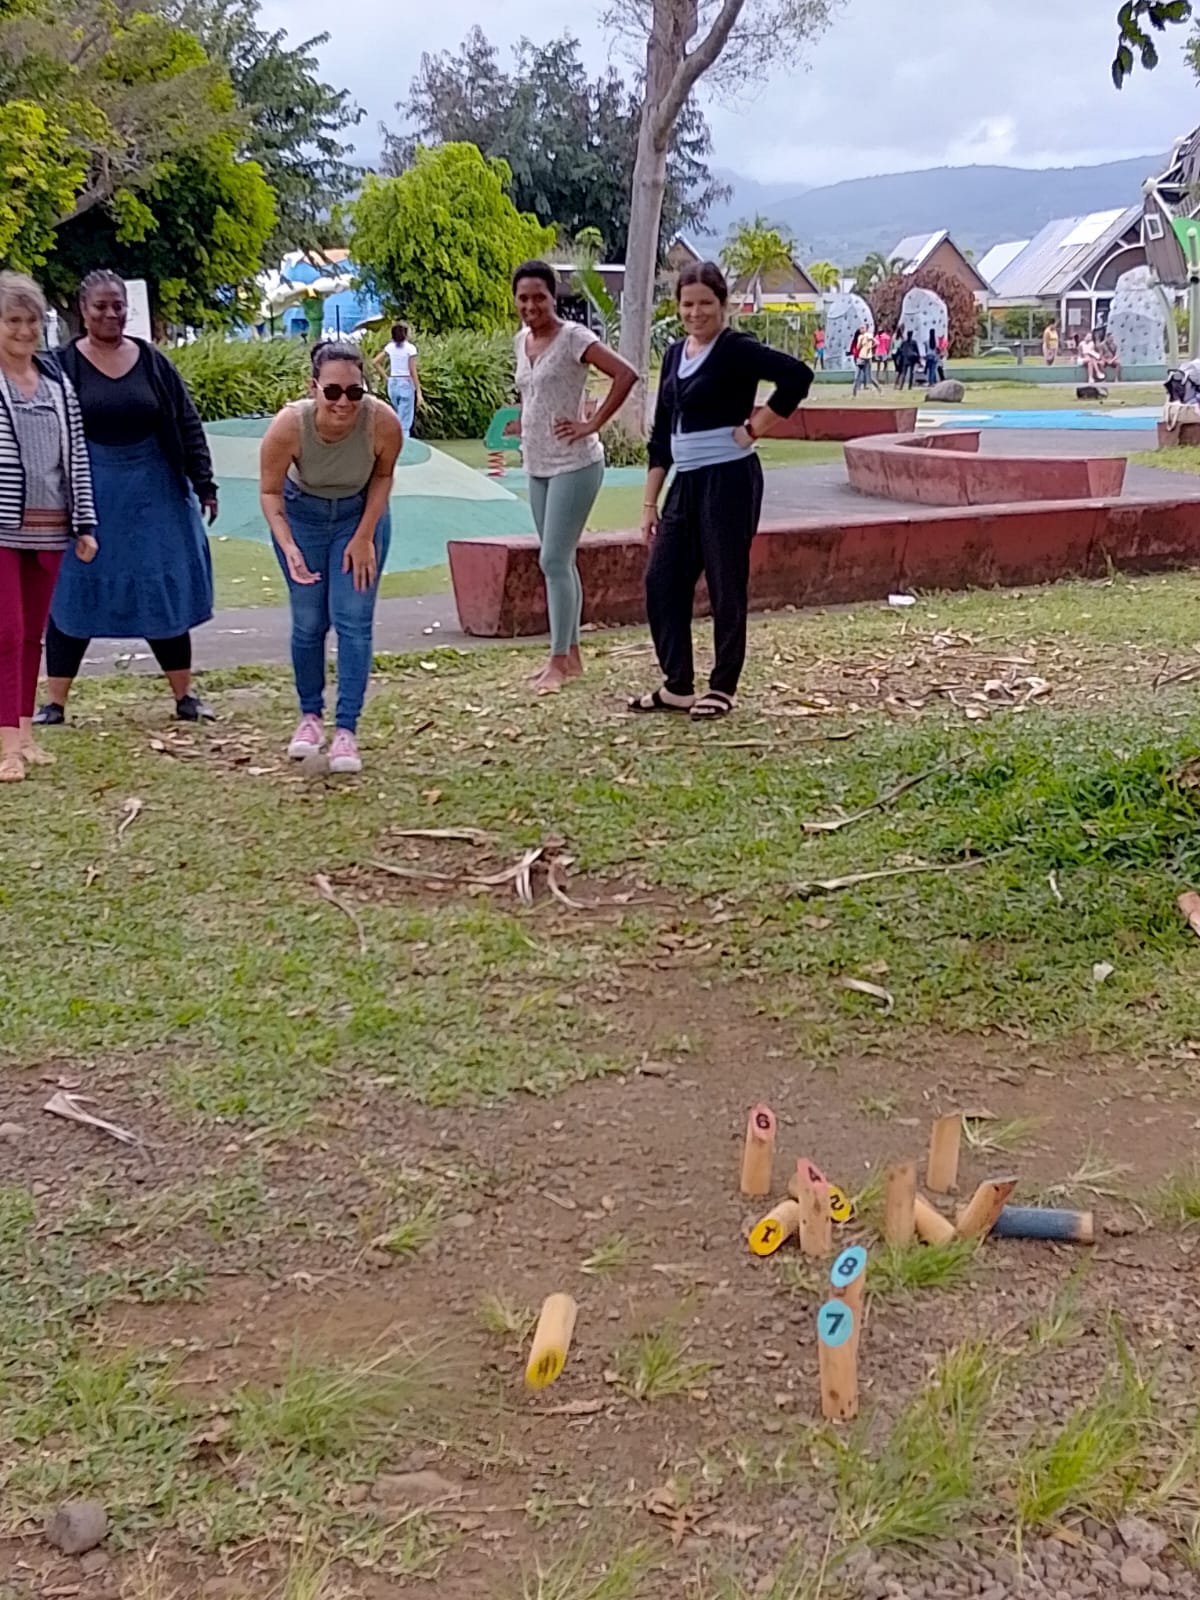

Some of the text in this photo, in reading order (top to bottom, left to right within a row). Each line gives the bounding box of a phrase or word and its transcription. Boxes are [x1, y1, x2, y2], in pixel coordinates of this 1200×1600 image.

[755, 1112, 770, 1130] 6
[838, 1256, 858, 1277] 8
[825, 1312, 845, 1336] 7
